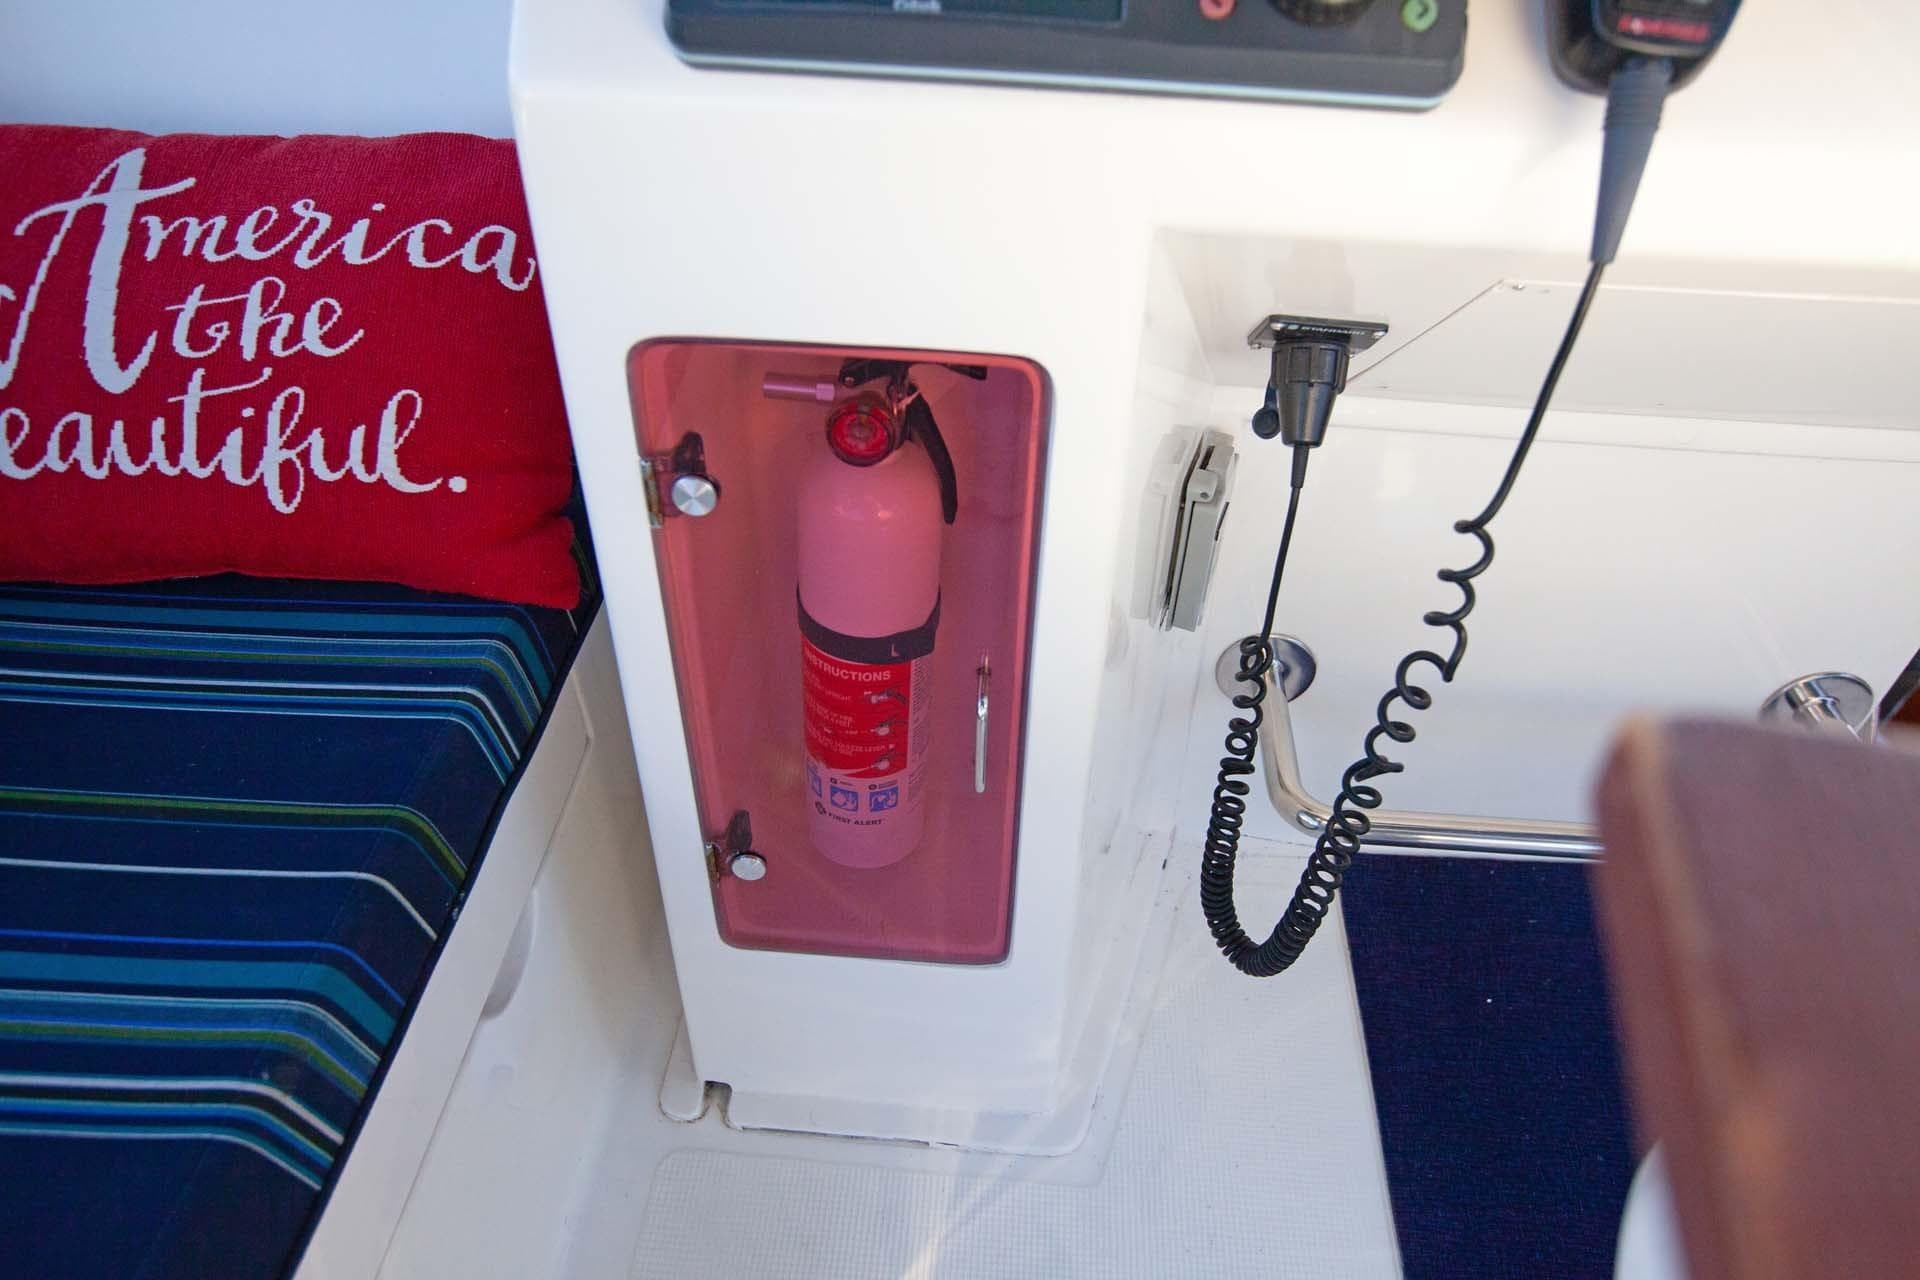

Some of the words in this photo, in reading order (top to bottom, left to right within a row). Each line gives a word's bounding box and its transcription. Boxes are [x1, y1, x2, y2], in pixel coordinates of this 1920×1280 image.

[0, 148, 536, 393] America
[165, 276, 364, 361] the
[0, 367, 467, 514] eautiful.
